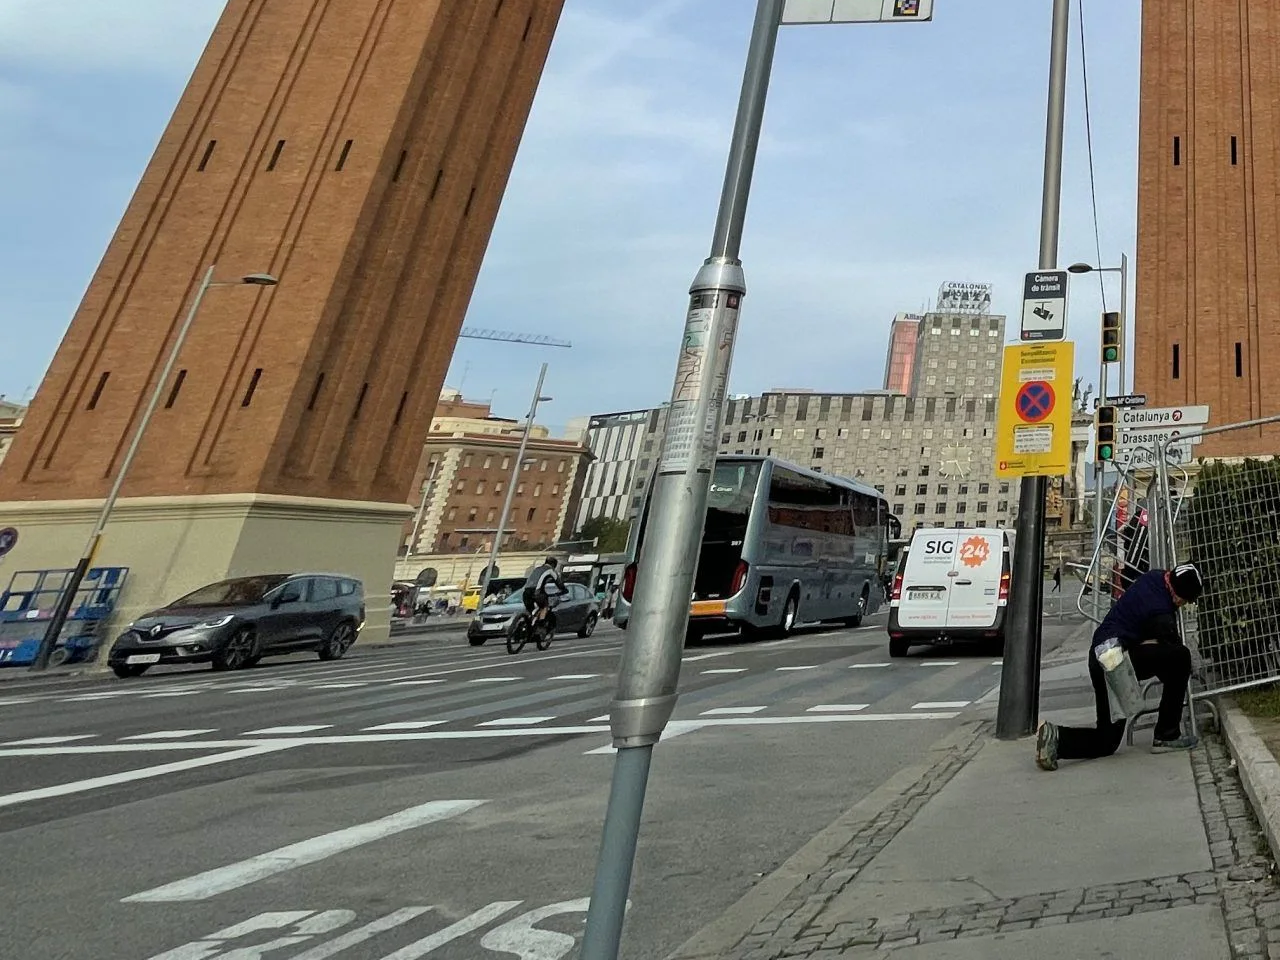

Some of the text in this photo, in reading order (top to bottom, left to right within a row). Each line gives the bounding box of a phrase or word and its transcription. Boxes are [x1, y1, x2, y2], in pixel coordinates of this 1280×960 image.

[948, 282, 988, 290] CATALONIA
[1031, 284, 1040, 292] de
[942, 291, 991, 302] PLAZA
[1123, 411, 1170, 423] Catalunya
[1122, 432, 1169, 444] Drassanes
[925, 540, 954, 554] SIG
[963, 544, 986, 558] 24
